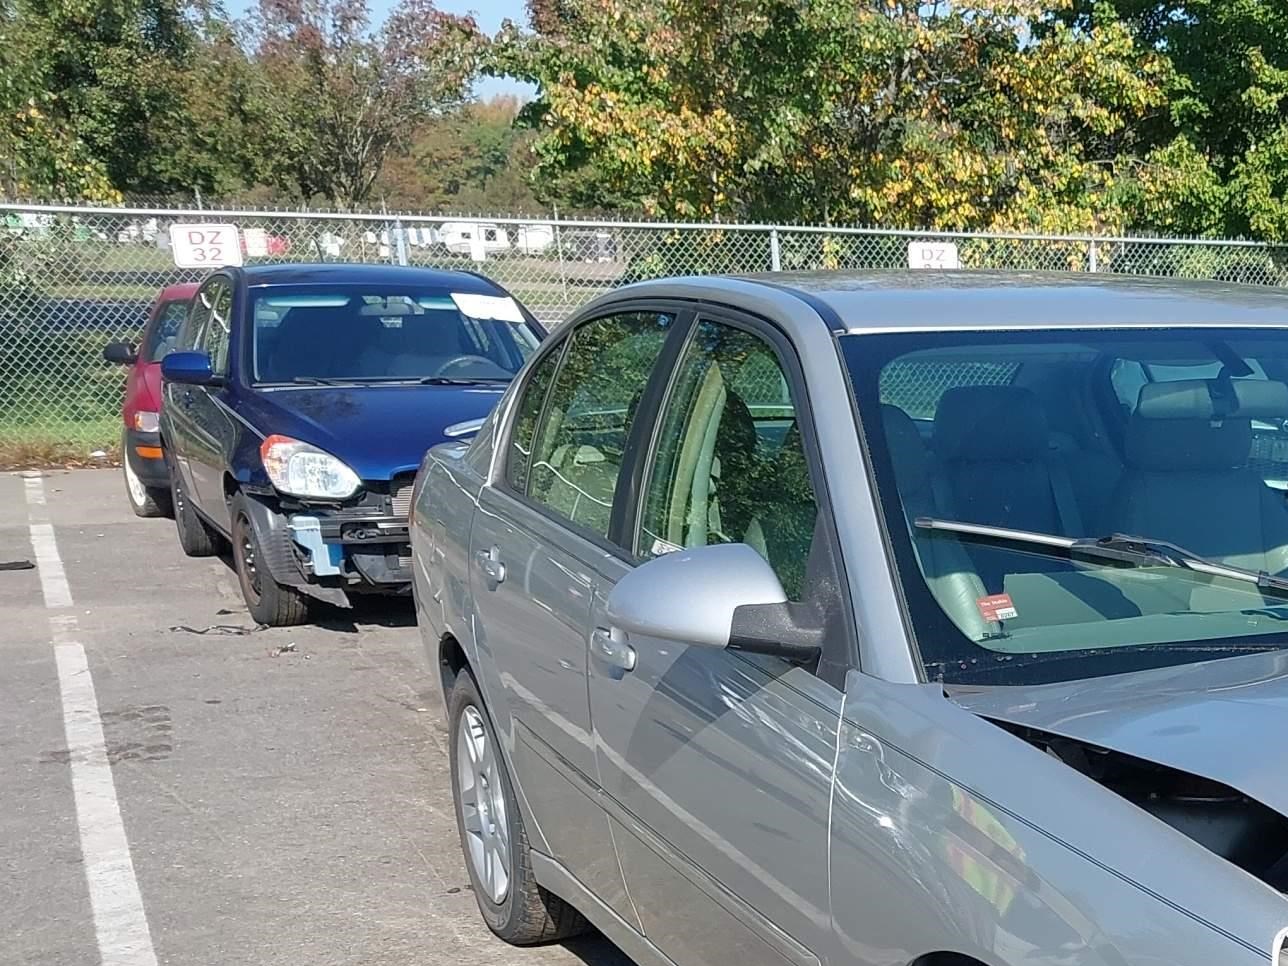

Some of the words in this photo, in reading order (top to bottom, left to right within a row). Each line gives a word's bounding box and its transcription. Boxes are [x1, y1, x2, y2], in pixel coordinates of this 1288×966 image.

[188, 231, 224, 245] DZ
[193, 247, 224, 262] 32
[921, 249, 945, 261] DZ
